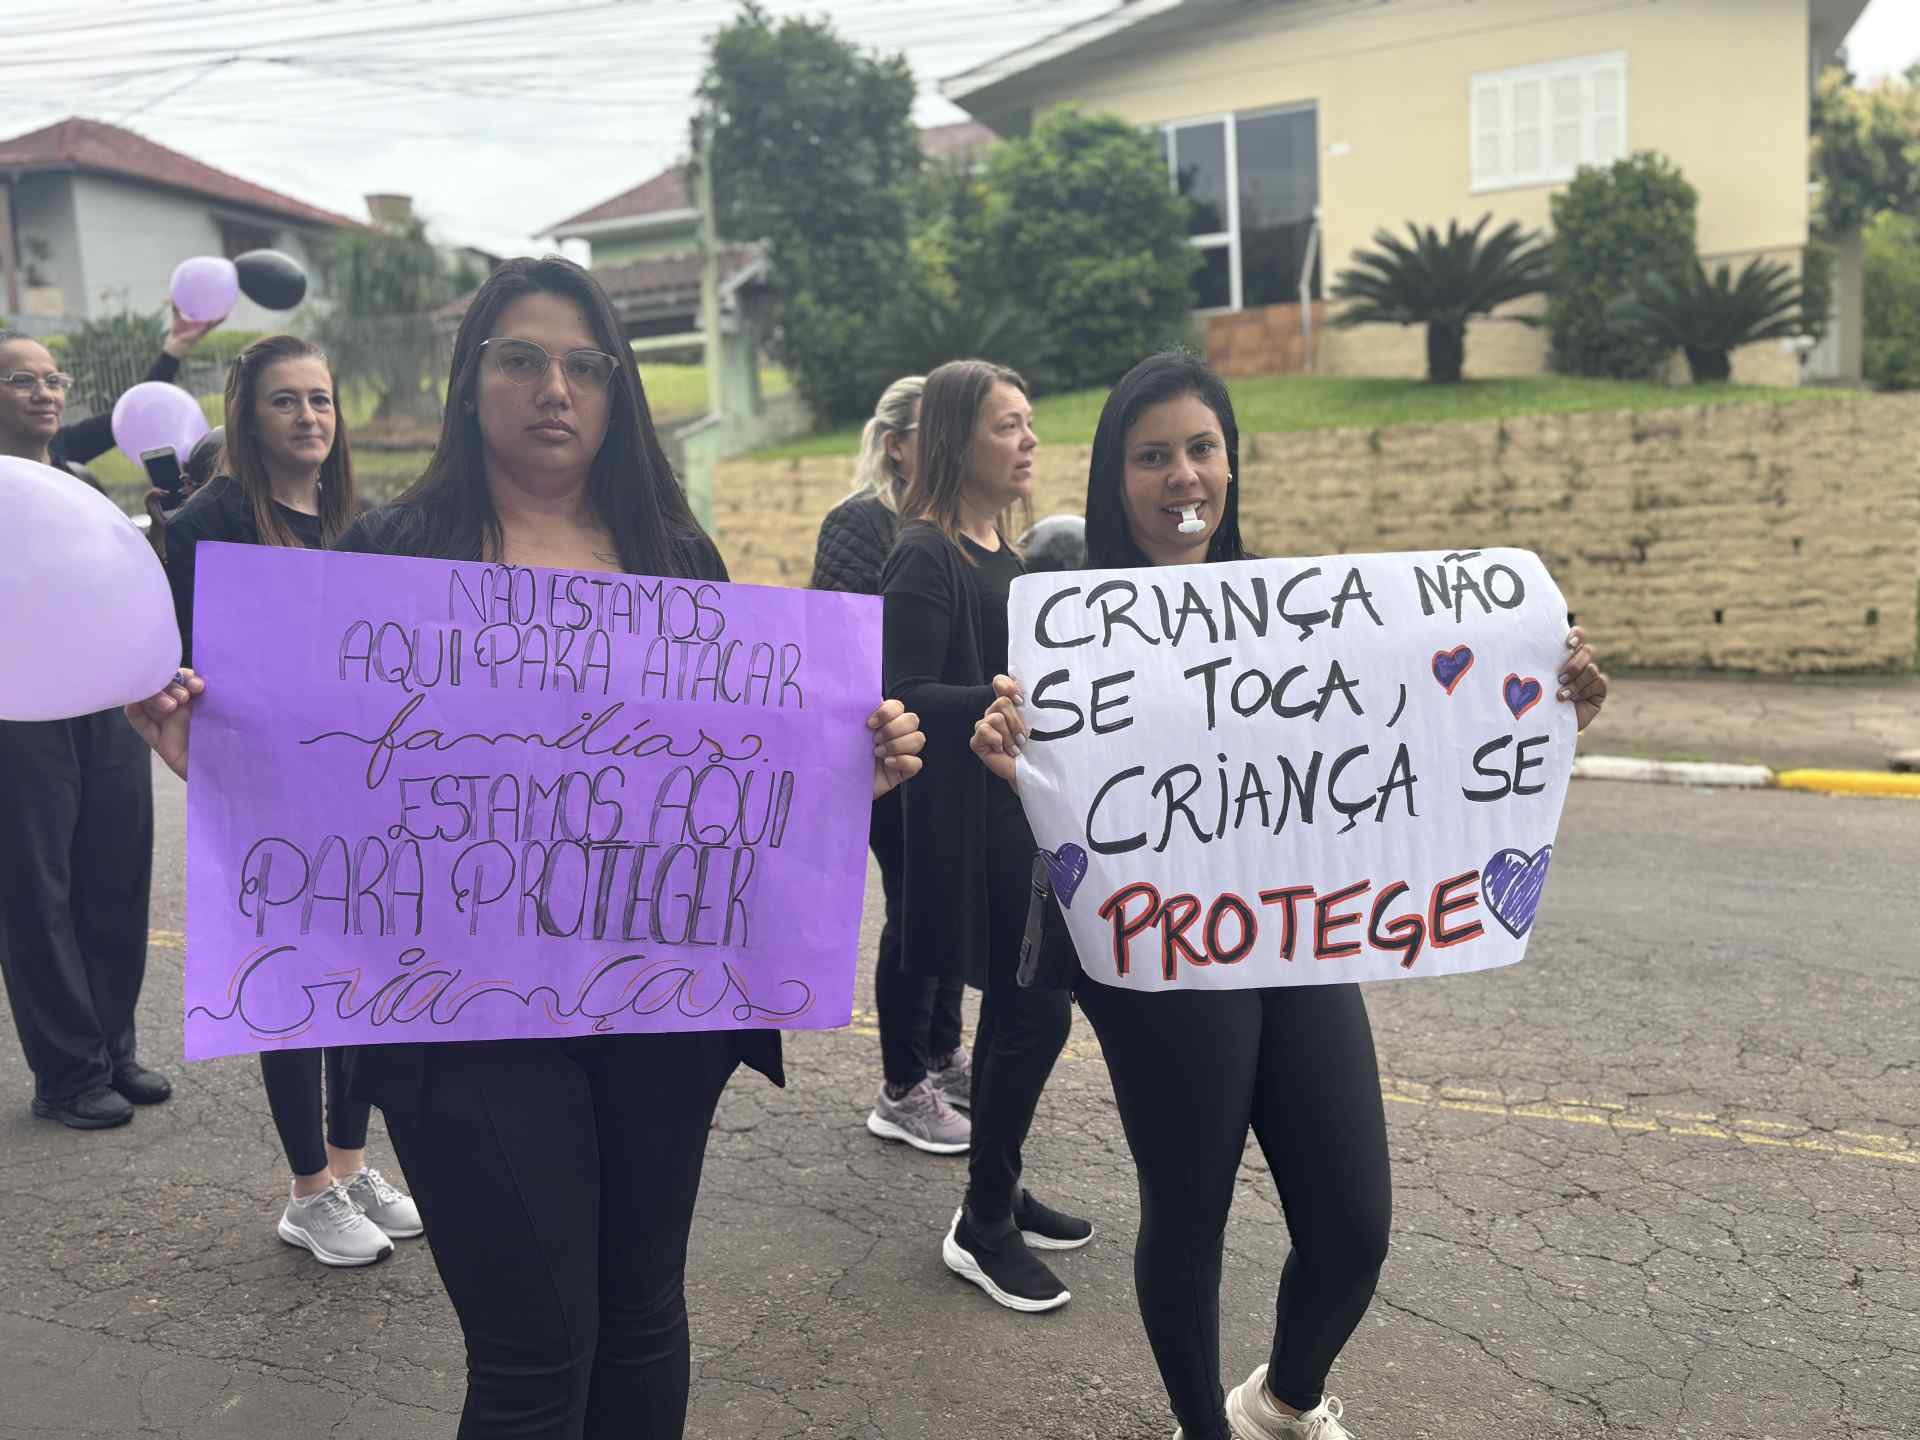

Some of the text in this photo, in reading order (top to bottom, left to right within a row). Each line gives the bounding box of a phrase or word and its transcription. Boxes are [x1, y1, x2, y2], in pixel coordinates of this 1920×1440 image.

[451, 563, 726, 642] NÃO ESTAMOS
[1033, 551, 1526, 649] CRIANÇA NÃO
[339, 620, 804, 708] AQUI PARA ATACAR
[1028, 668, 1136, 742] SE
[388, 763, 797, 849] ESTAMOS AQUI
[1461, 733, 1551, 803] SE
[238, 835, 758, 948] PARA PROTEGER
[1098, 868, 1486, 981] PROTEGE
